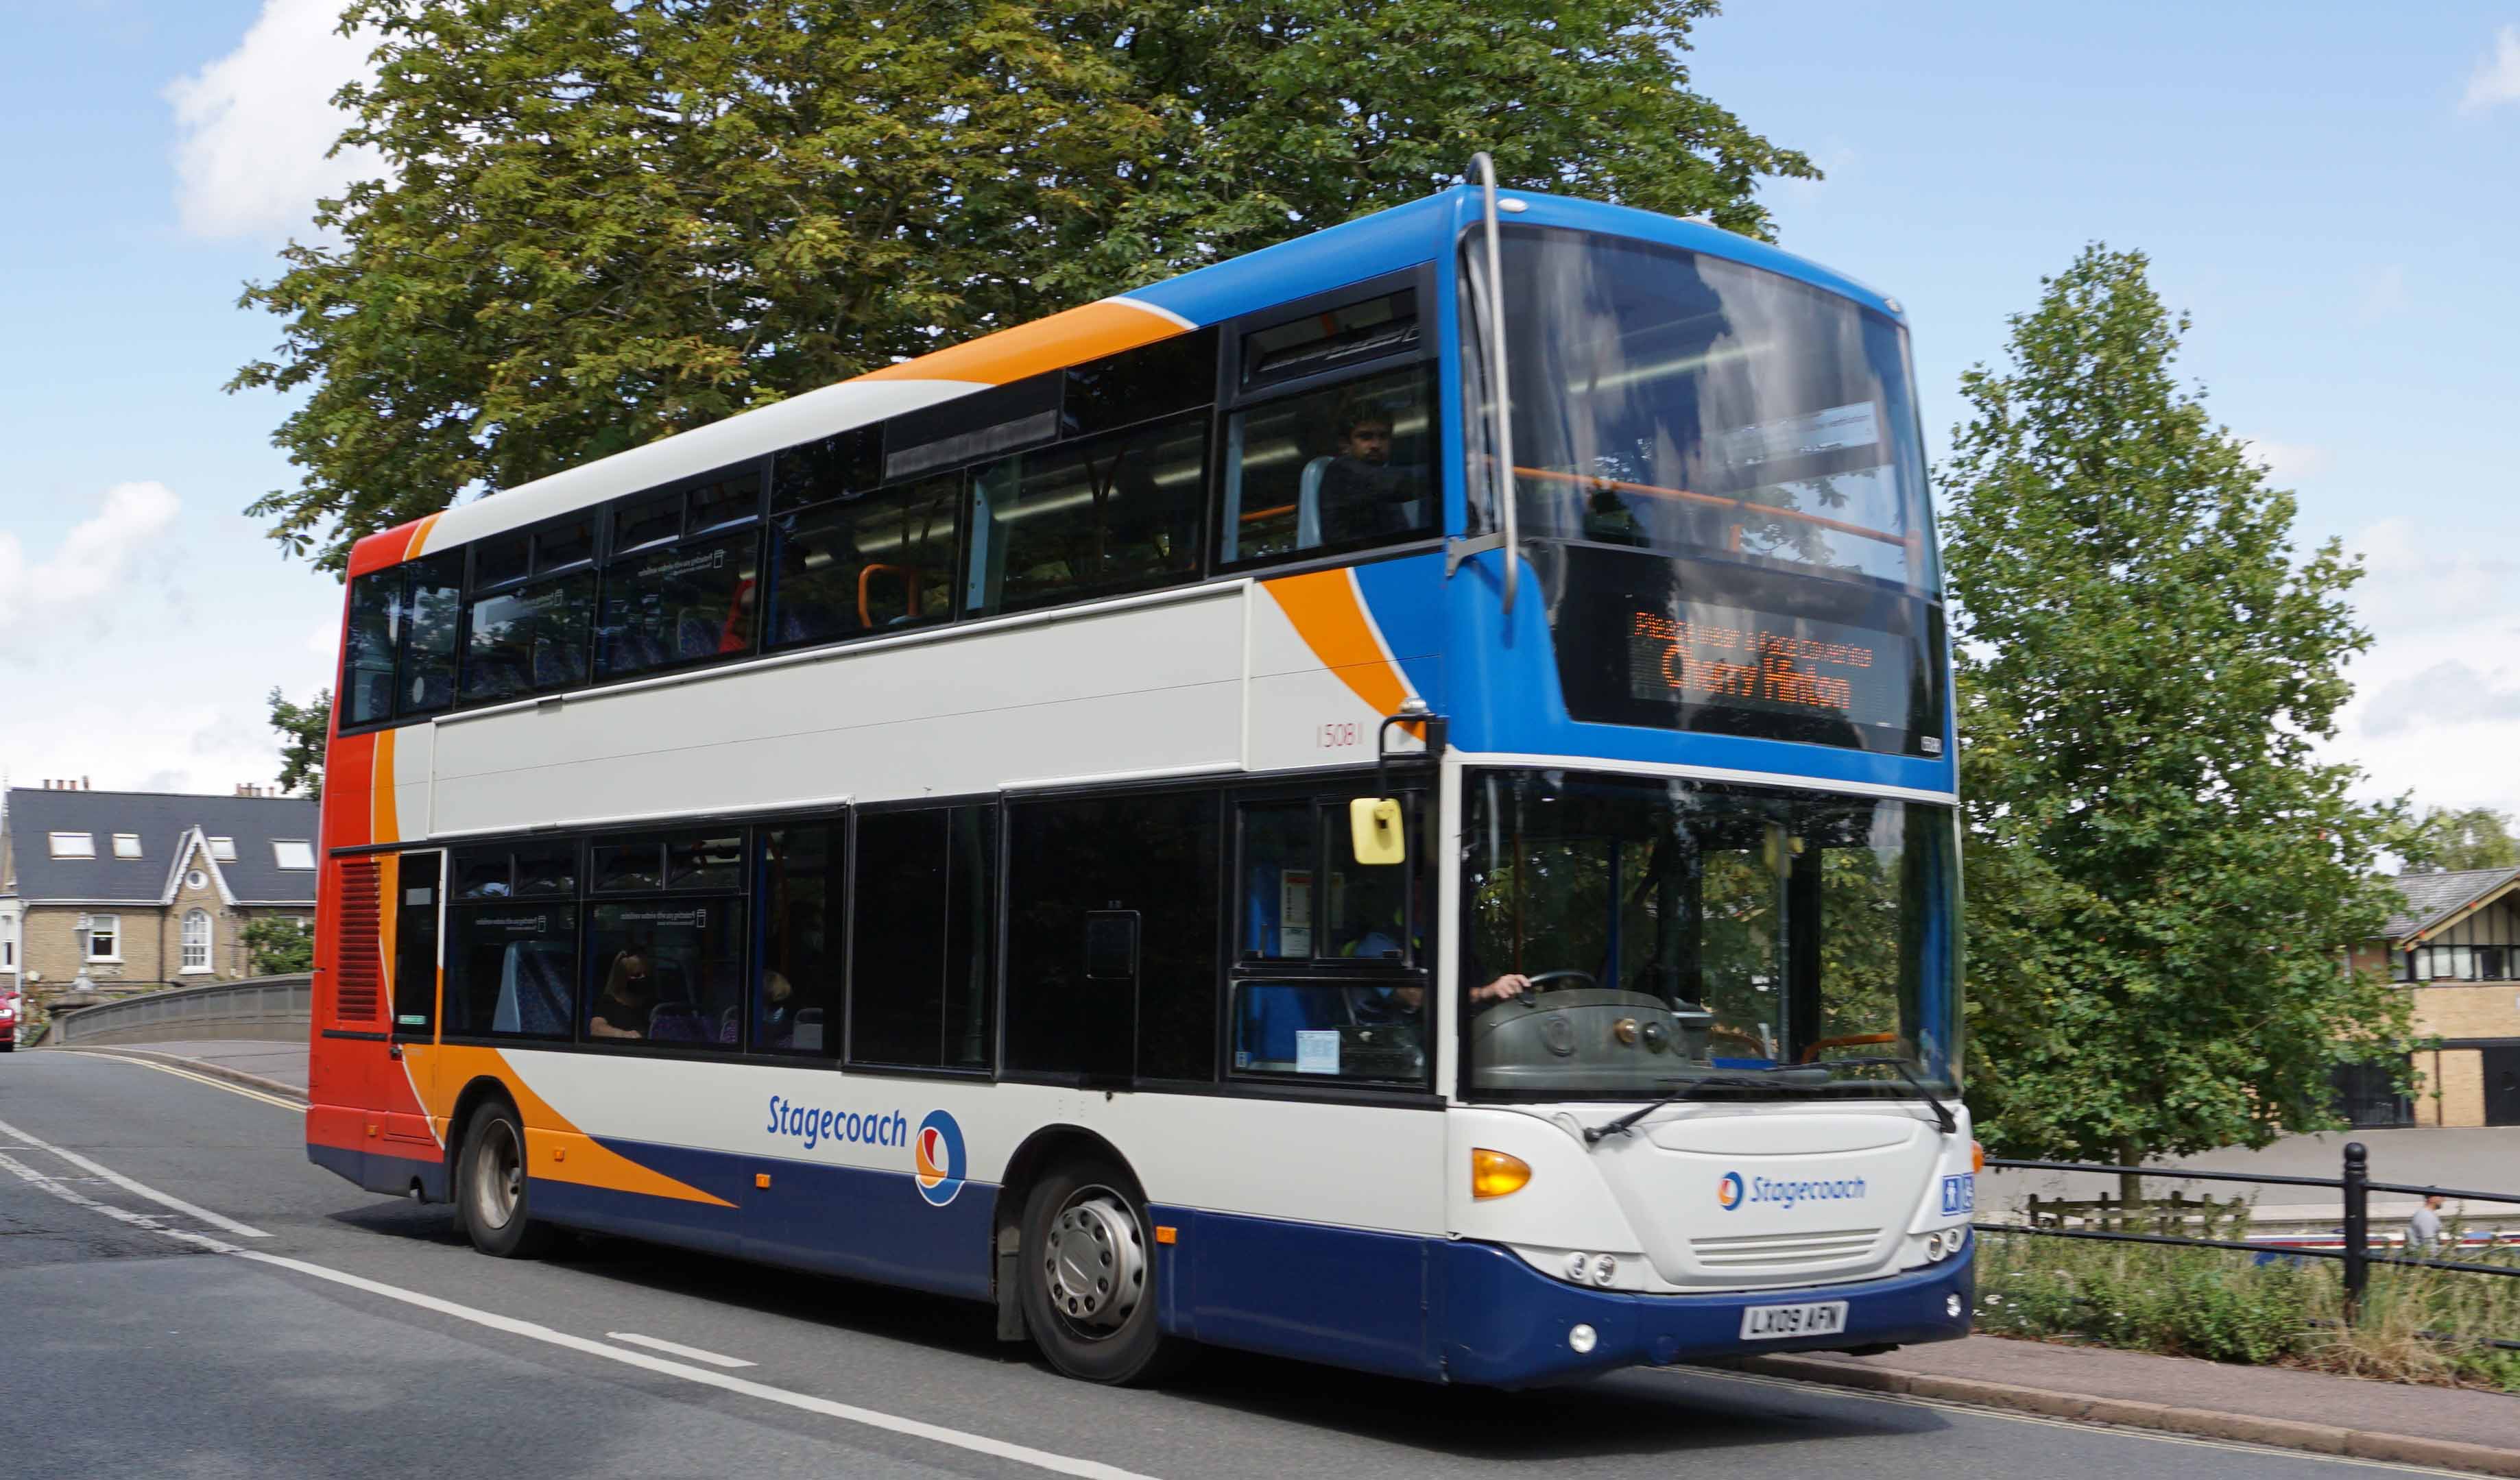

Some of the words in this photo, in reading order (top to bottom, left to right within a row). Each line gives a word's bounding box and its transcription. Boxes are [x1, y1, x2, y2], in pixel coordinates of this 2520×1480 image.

[1661, 644, 1758, 696] Cherry
[1762, 657, 1850, 709] Hinton
[767, 1095, 907, 1150] Stagecoach
[1750, 1175, 1866, 1209] Stagecoach
[1750, 1309, 1801, 1334] LX09
